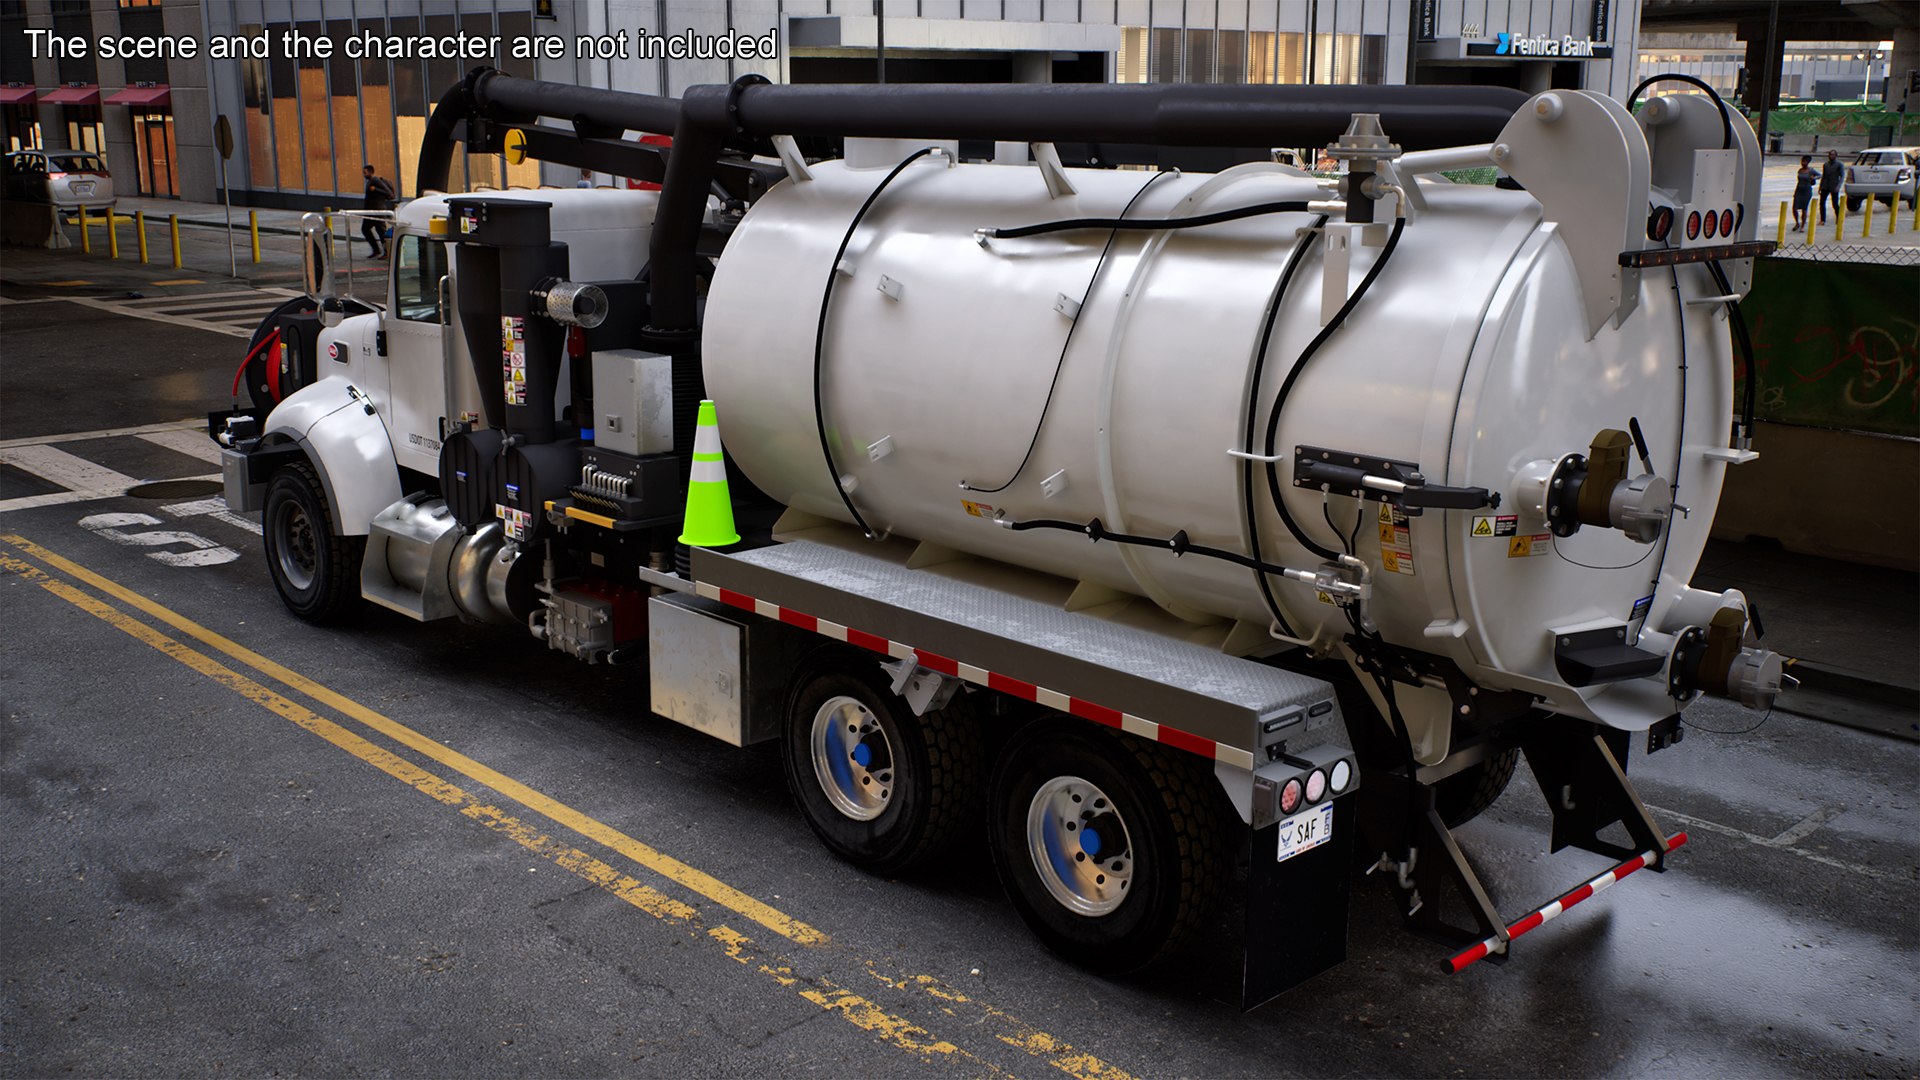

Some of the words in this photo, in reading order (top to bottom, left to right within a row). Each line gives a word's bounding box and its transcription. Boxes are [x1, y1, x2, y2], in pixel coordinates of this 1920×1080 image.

[1423, 17, 1431, 37] Bank
[1511, 32, 1560, 56] Fentica
[1562, 34, 1594, 57] Bank
[1297, 818, 1317, 844] SAF
